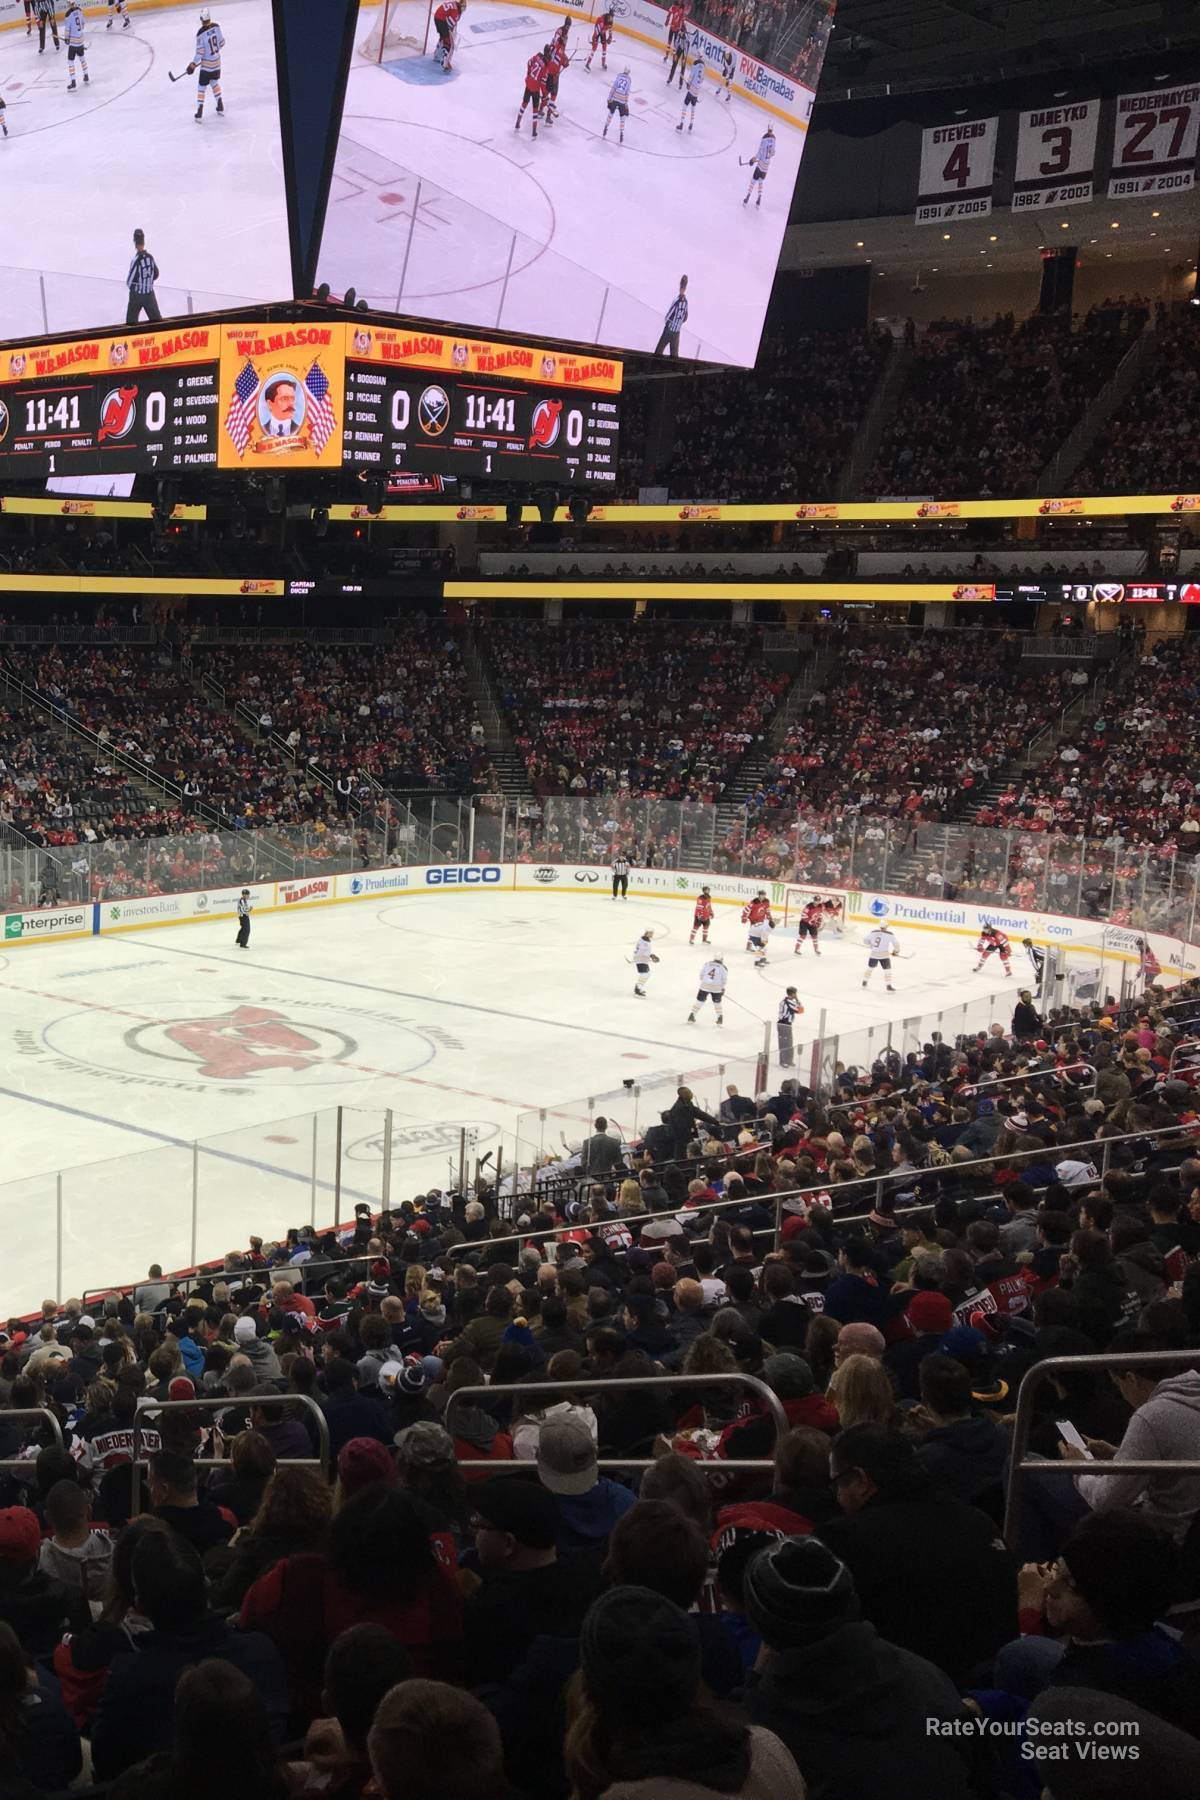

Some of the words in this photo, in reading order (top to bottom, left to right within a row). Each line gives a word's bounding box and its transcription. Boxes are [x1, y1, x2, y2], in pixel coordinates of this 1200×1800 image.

[208, 36, 219, 55] 19
[531, 64, 541, 77] 21
[740, 56, 795, 101] RWJBarnabas
[617, 79, 627, 90] 23
[744, 79, 768, 98] HEALTH
[1030, 105, 1087, 128] DANEYKO
[933, 122, 986, 144] STEVENS
[1121, 106, 1191, 164] 27
[1039, 126, 1072, 175] 3
[942, 143, 970, 188] 4
[1113, 181, 1140, 195] 1991
[1157, 173, 1191, 189] 2004
[1014, 192, 1040, 207] 1982
[1060, 186, 1089, 200] 2003
[918, 206, 942, 220] 1991
[958, 201, 987, 215] 2005
[227, 331, 242, 339] WHO
[243, 330, 258, 338] BUT
[236, 328, 332, 356] W.B.MASON
[138, 331, 209, 364] W.B.MASON
[382, 337, 443, 359] W.B.MASON
[35, 344, 99, 375] W.B.MASON
[477, 350, 533, 371] W.B.MASON
[350, 373, 354, 382] 4
[357, 374, 386, 386] BOGOSIAN
[564, 362, 614, 382] W.B.MASON
[178, 378, 183, 387] 6
[187, 376, 213, 387] GREENE
[174, 398, 182, 407] 28
[186, 394, 218, 406] SEVERSON
[346, 392, 353, 401] 19
[357, 392, 382, 404] MCCABE
[26, 396, 80, 431] 11:41
[146, 391, 166, 431] 0
[391, 390, 410, 430] 0
[465, 394, 515, 431] 11:41
[591, 402, 596, 410] 6
[597, 402, 616, 413] GREENE
[174, 417, 182, 425] 44
[186, 415, 207, 425] WOOD
[348, 411, 353, 420] 9
[356, 412, 377, 423] EICHEL
[596, 420, 619, 430] SEVERSON
[566, 409, 583, 446] 0
[14, 442, 34, 450] PENALTY
[71, 439, 92, 447] PENALTY
[174, 436, 182, 444] 19
[185, 434, 208, 444] ZAJAC
[344, 431, 352, 440] 23
[355, 432, 384, 442] REINHART
[454, 438, 473, 446] PENALTY
[482, 440, 497, 448] PERIOD
[506, 442, 524, 451] PENALTY
[587, 436, 594, 444] 44
[596, 437, 611, 446] WOOD
[49, 455, 55, 472] 1
[152, 456, 157, 466] 7
[174, 455, 181, 464] 21
[185, 453, 216, 463] PALMIERI
[343, 450, 351, 460] 53
[354, 452, 380, 461] SKINNER
[395, 454, 401, 465] 6
[486, 455, 491, 473] 1
[587, 453, 593, 462] 19
[595, 454, 611, 463] ZAJAC
[570, 468, 575, 479] 7
[585, 470, 592, 479] 21
[593, 471, 616, 480] PALMIERI
[1132, 588, 1158, 598] 11:41
[365, 874, 409, 890] Prudential
[425, 867, 501, 884] GEICO
[285, 880, 328, 903] W.B.MASON
[11, 913, 83, 932] enterprise
[894, 903, 965, 925] Prudential
[977, 912, 1029, 930] Walmart
[1047, 924, 1073, 937] com
[873, 936, 881, 948] 9
[707, 968, 717, 980] 4
